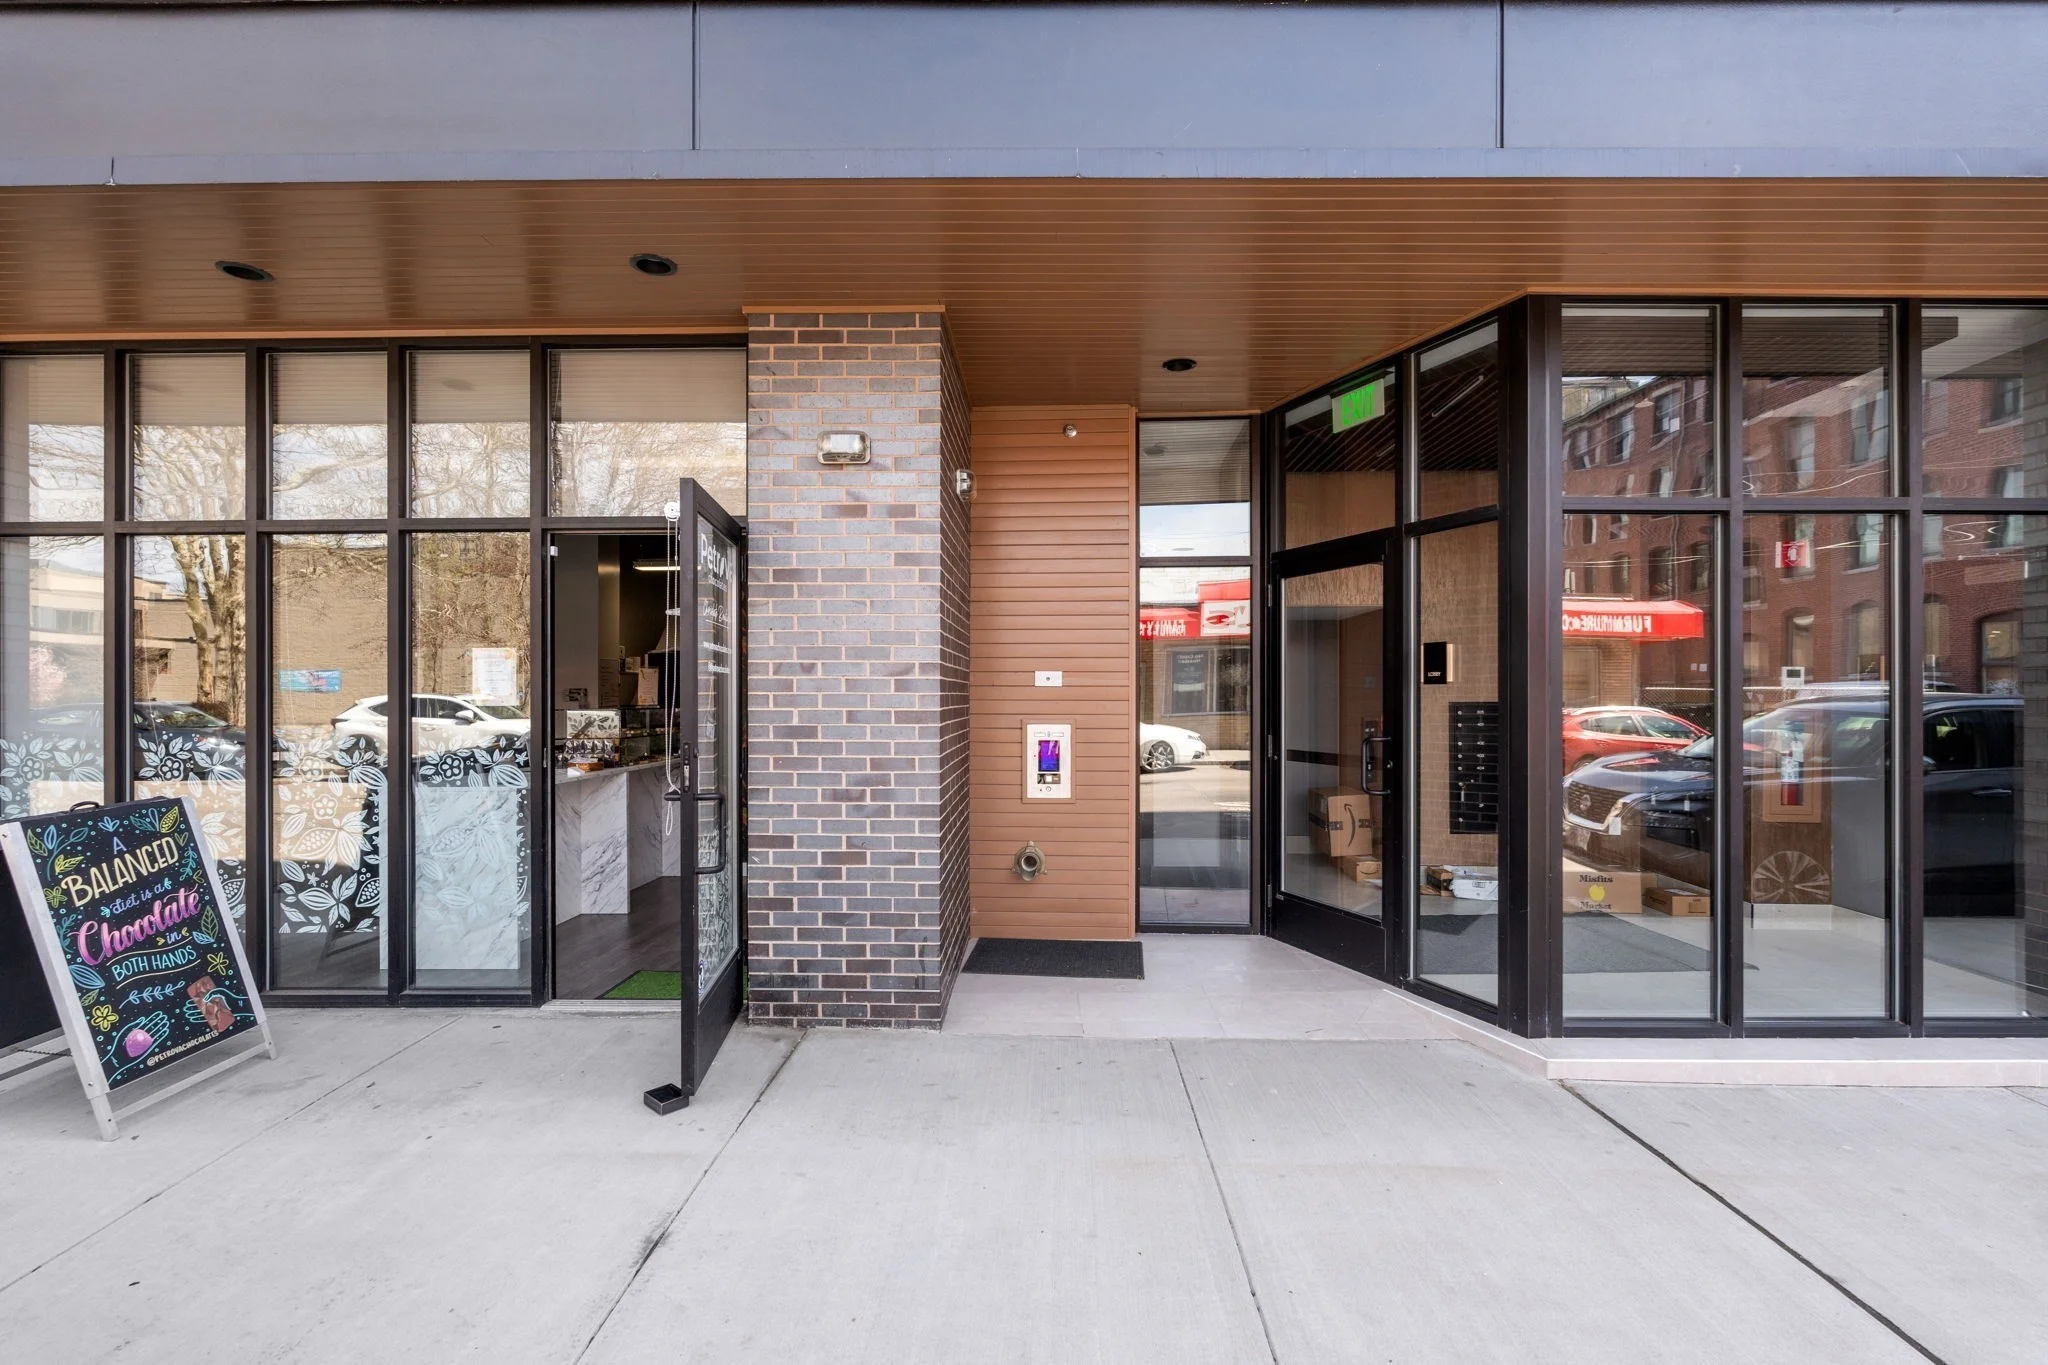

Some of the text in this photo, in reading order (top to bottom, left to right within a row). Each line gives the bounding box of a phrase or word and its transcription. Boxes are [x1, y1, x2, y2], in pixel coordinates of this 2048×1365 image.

[1341, 384, 1375, 427] EXIT
[112, 836, 127, 855] A
[60, 836, 179, 907] BALANCED
[1579, 874, 1613, 883] Misfits
[110, 882, 165, 914] diet is a
[1580, 901, 1612, 910] Market
[67, 883, 201, 966] Chocolate
[165, 931, 182, 945] in
[111, 945, 197, 981] BOTH HANDS
